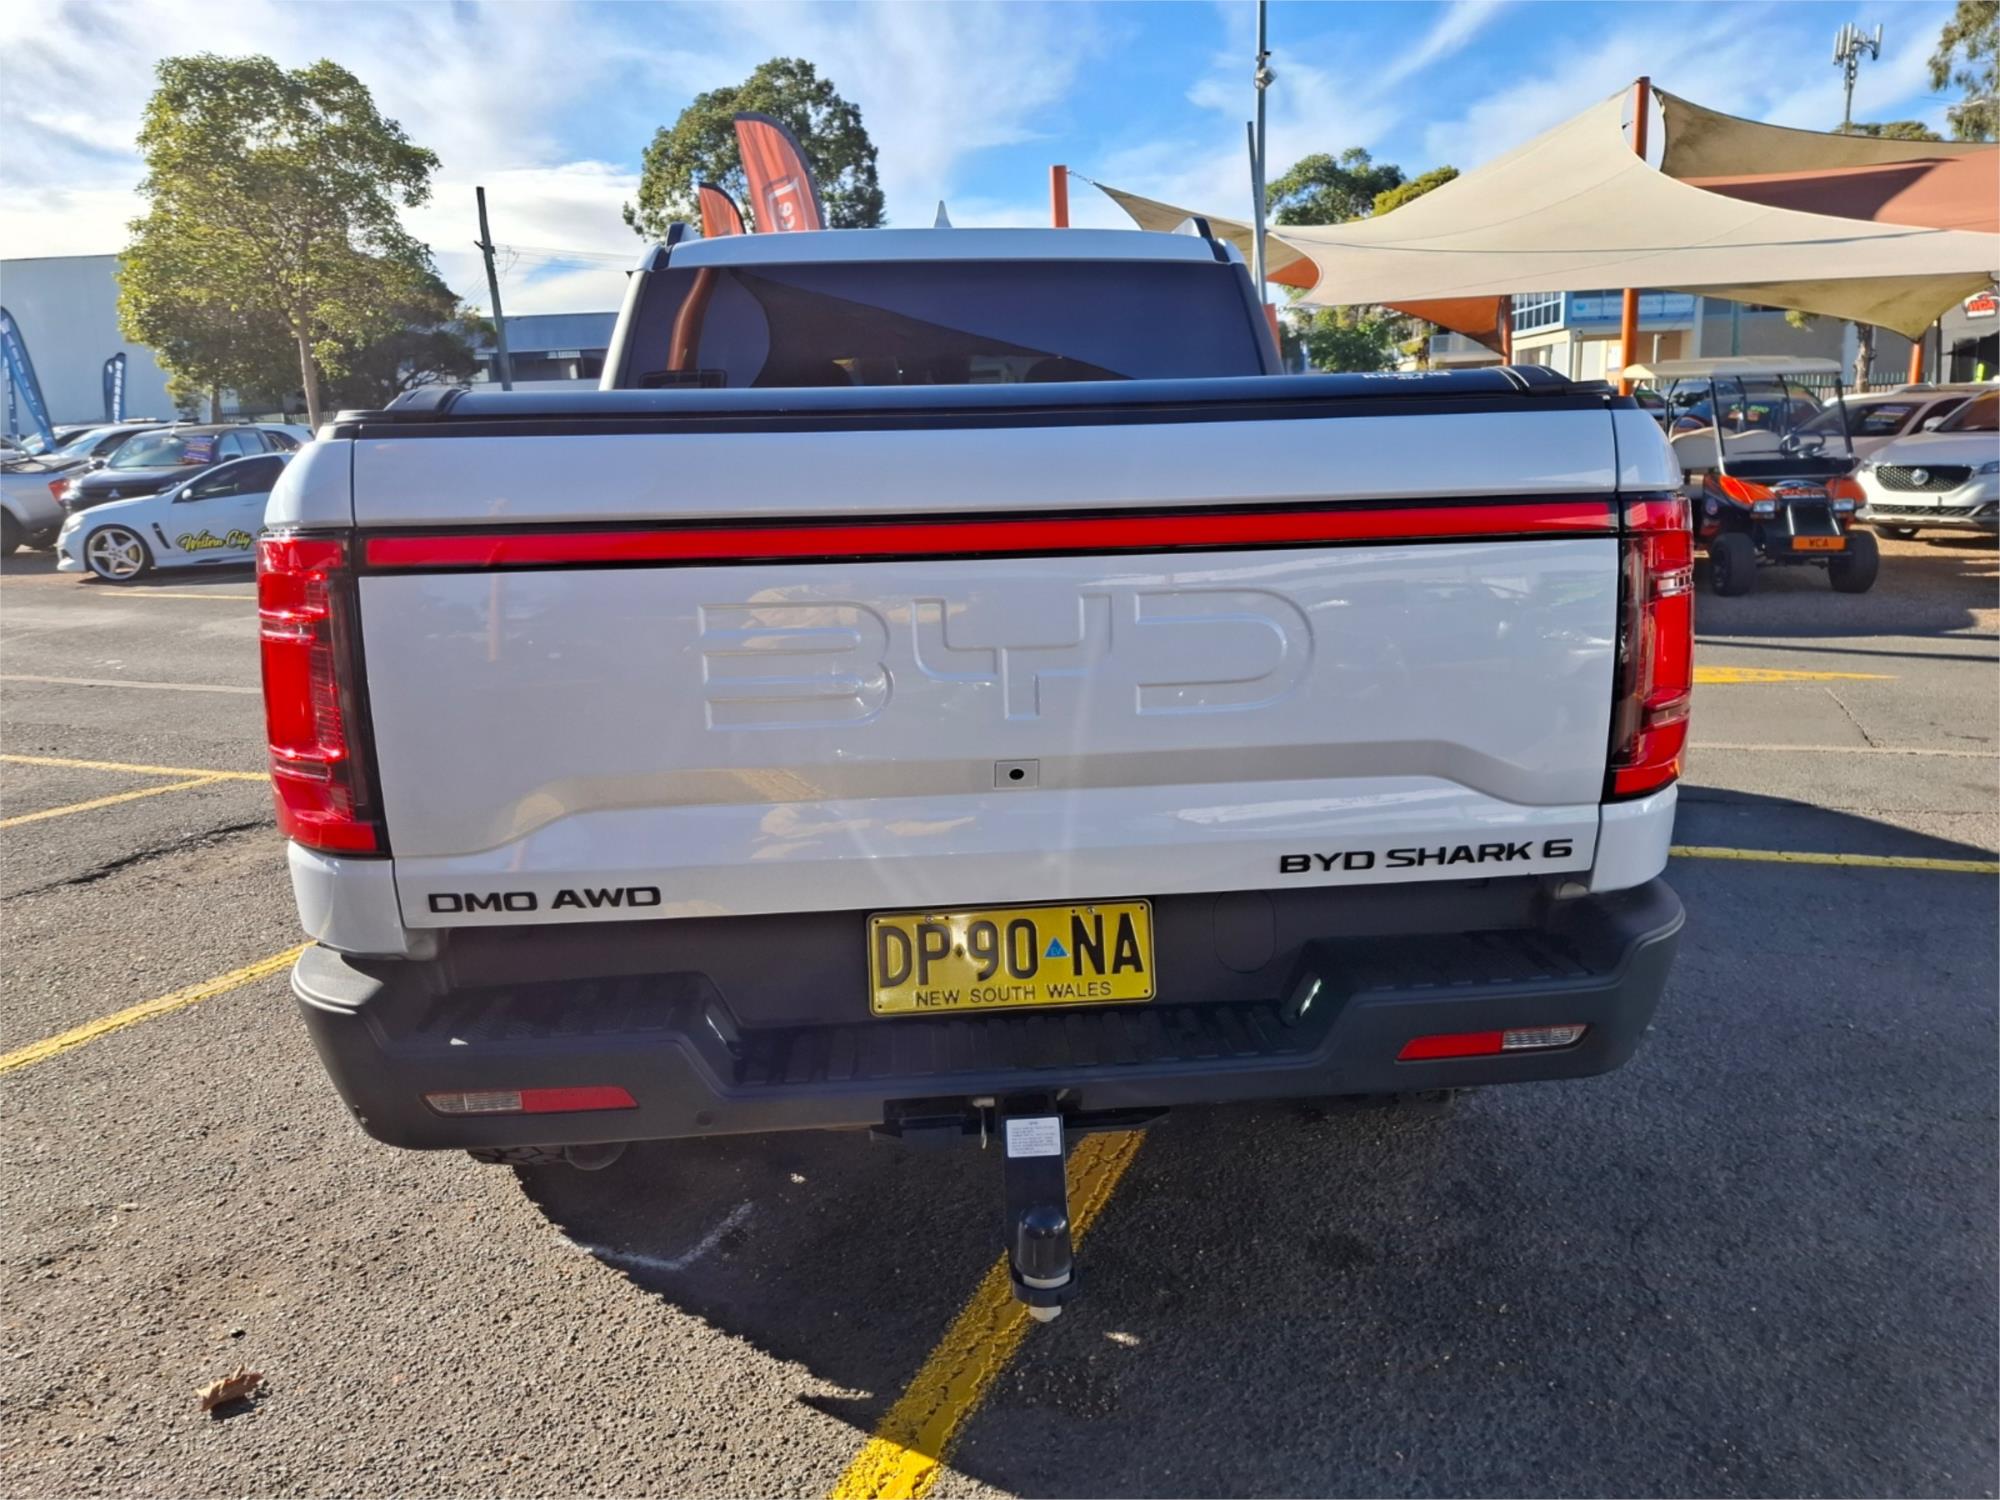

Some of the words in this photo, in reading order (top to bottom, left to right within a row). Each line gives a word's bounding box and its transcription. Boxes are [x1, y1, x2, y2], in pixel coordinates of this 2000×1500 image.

[225, 529, 252, 551] City
[1808, 538, 1830, 548] WCA
[698, 587, 1317, 732] BYD
[1279, 850, 1375, 874] BYD
[1385, 841, 1534, 868] SHARK
[1542, 838, 1574, 859] 6
[427, 891, 538, 913] DMO
[551, 886, 662, 909] AWD
[916, 990, 960, 1007] NEW
[970, 985, 1036, 1003] SOUTH
[1047, 981, 1112, 997] WALES
